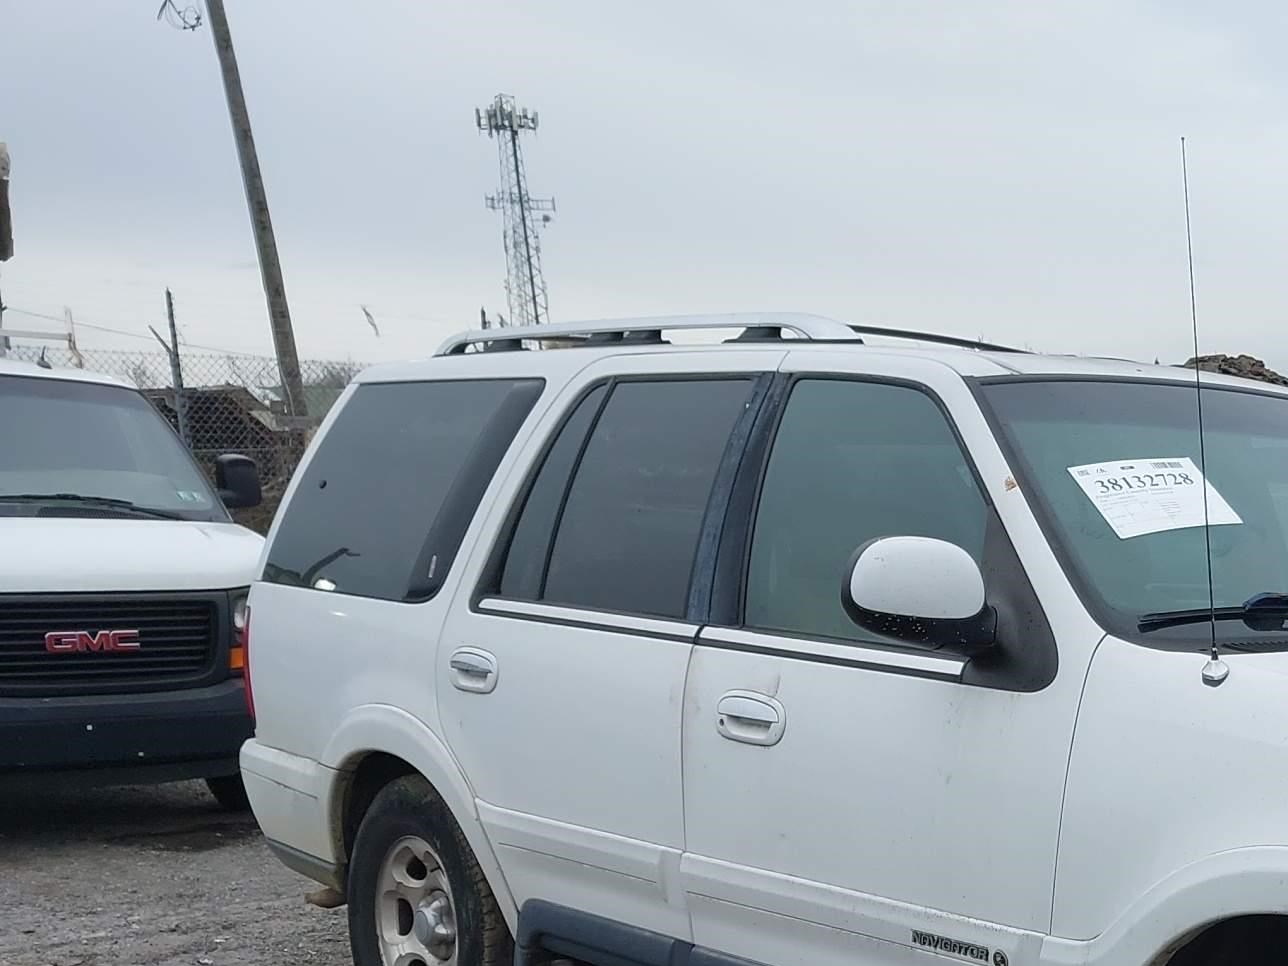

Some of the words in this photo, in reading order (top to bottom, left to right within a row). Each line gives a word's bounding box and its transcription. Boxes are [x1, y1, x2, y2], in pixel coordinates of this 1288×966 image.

[1095, 472, 1194, 493] 38132728
[45, 630, 140, 653] GMC
[911, 929, 989, 961] NAVIGATOR
